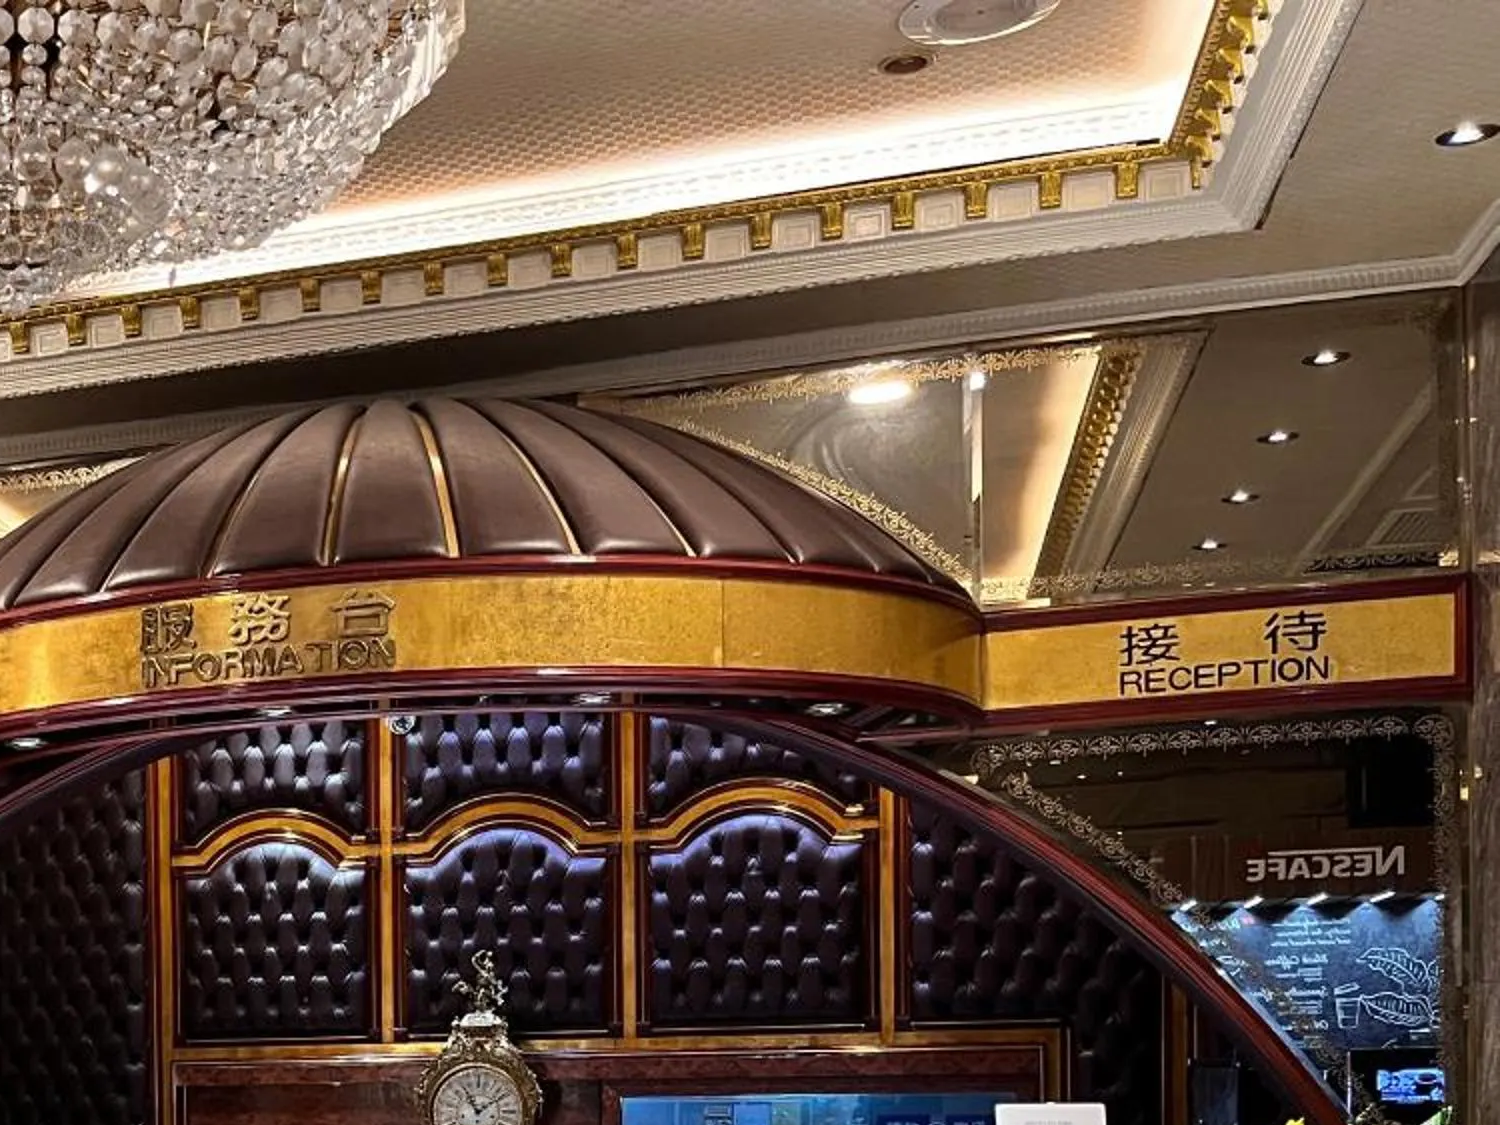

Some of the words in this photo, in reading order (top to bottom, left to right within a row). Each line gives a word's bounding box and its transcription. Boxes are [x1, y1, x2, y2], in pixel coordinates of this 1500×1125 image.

[140, 588, 396, 653] 服務台
[1119, 610, 1327, 666] 接待
[140, 637, 396, 688] INFORMATION
[1119, 655, 1329, 696] RECEPTION
